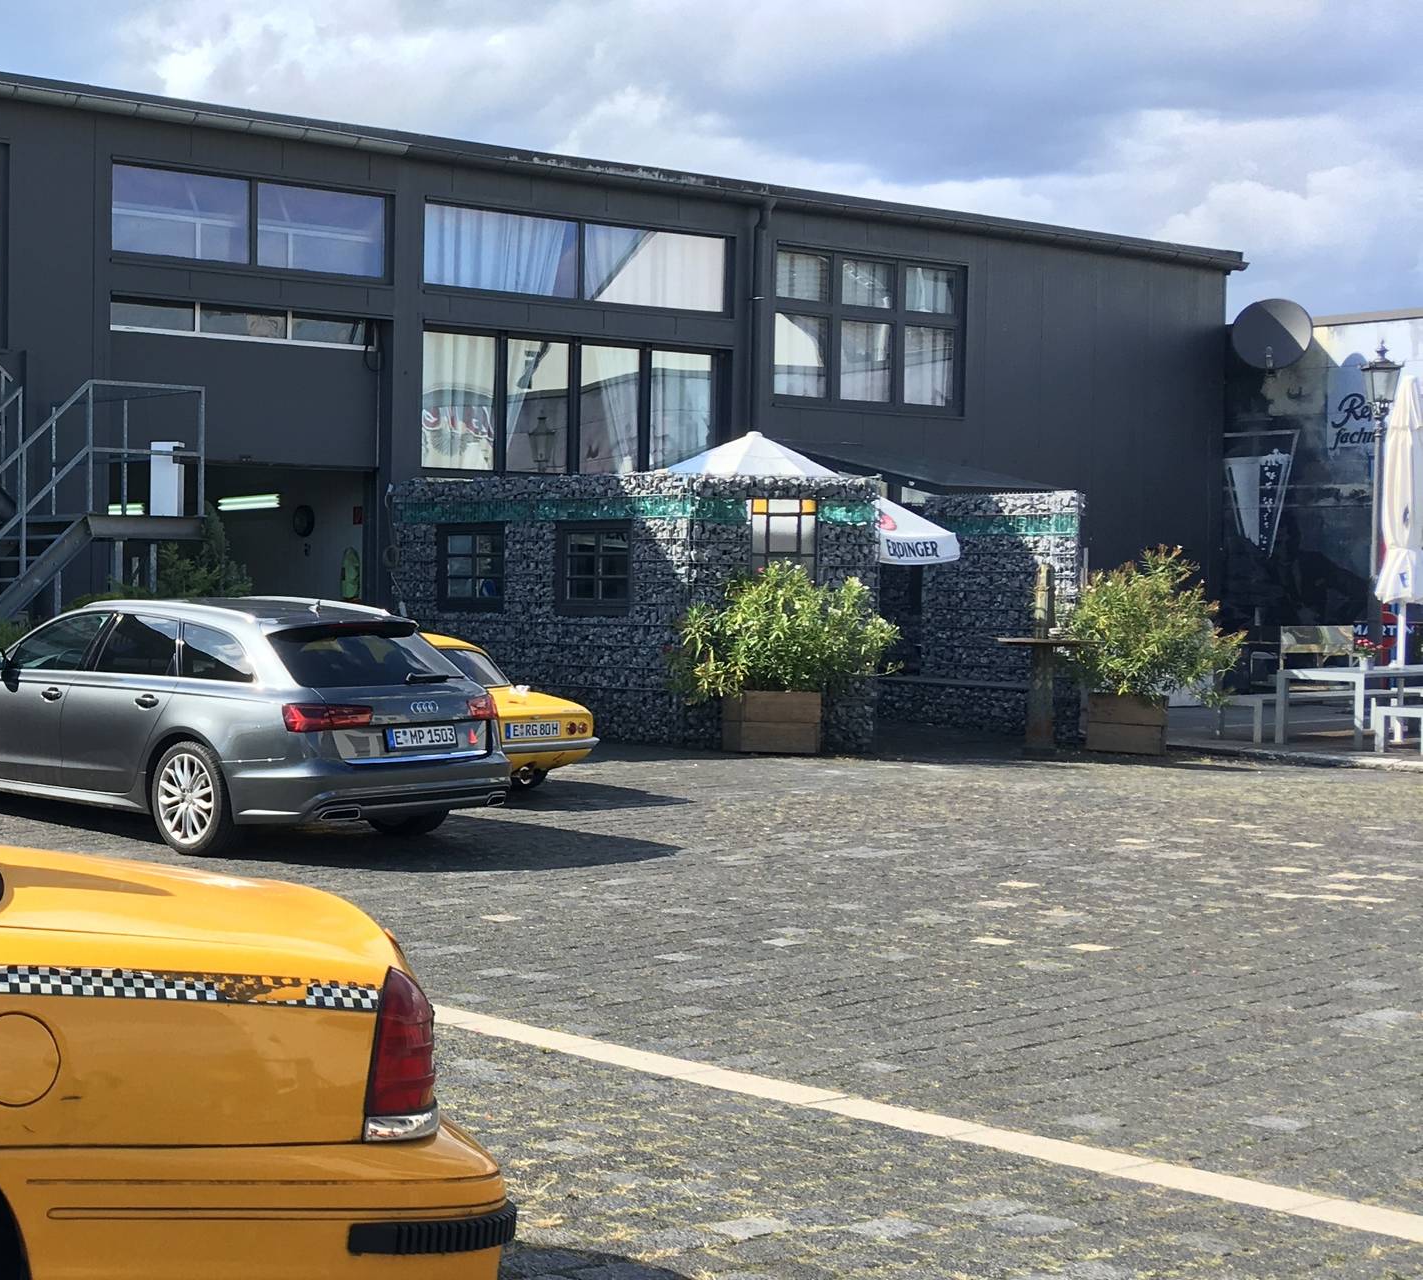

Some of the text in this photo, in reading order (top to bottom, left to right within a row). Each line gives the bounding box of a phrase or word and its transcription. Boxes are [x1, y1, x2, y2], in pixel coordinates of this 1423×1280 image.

[886, 538, 940, 560] ERDINGER
[409, 730, 425, 744] MP
[427, 728, 455, 744] 1503
